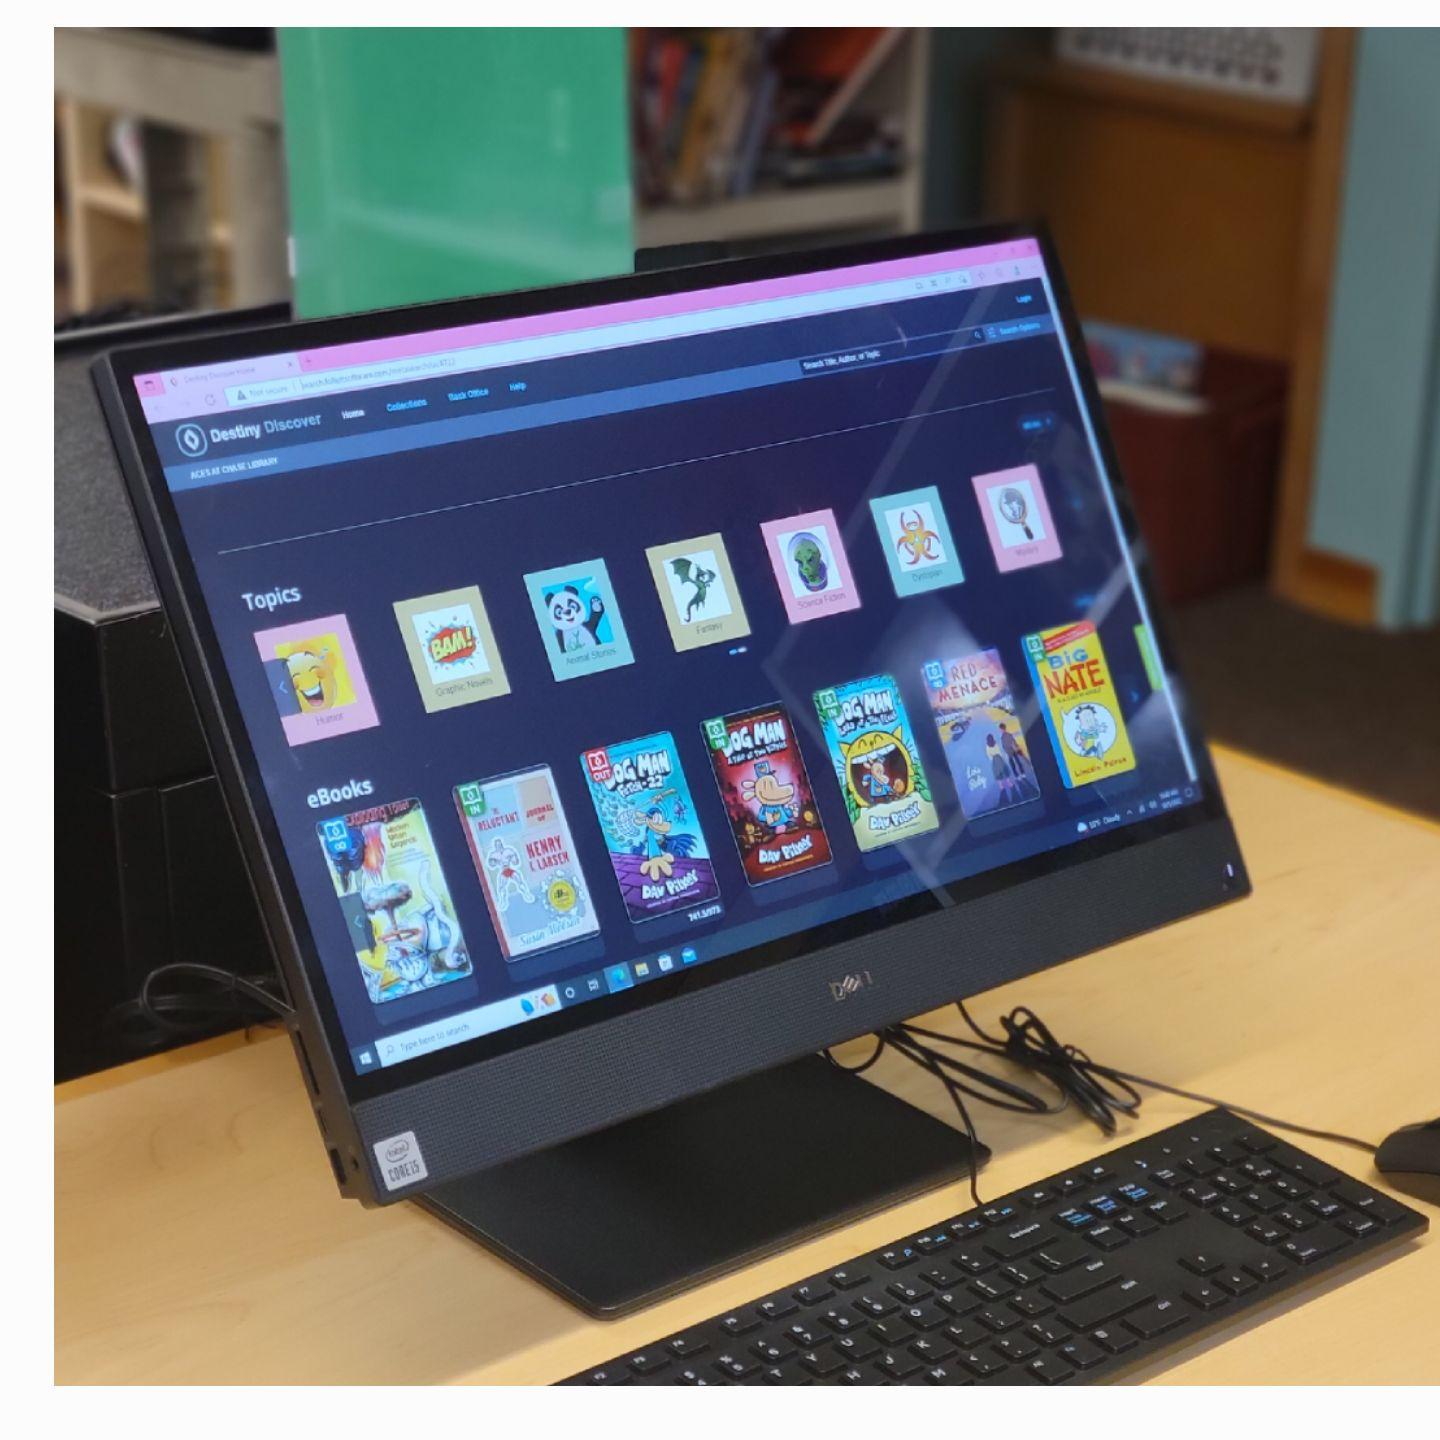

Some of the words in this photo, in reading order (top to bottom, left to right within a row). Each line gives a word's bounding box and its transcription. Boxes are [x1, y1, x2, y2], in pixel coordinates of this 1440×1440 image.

[341, 408, 365, 420] Home
[386, 398, 428, 412] Collections
[509, 382, 527, 392] Help
[210, 423, 261, 444] Destiny
[264, 415, 322, 433] Discover
[241, 586, 302, 613] Topics
[431, 626, 473, 661] BAM!
[951, 662, 978, 681] RED
[1044, 658, 1105, 699] NATE
[435, 683, 466, 698] Graphic
[864, 689, 894, 715] MAN
[939, 676, 999, 703] MENACE
[754, 719, 787, 746] MAN
[592, 767, 612, 782] OUT
[637, 749, 672, 779] MAN
[307, 780, 373, 809] eBooks
[469, 804, 481, 815] IN
[477, 810, 520, 832] RELUCTANT
[526, 835, 563, 859] HENRY
[536, 851, 570, 871] LARSEN
[642, 883, 665, 900] DAV
